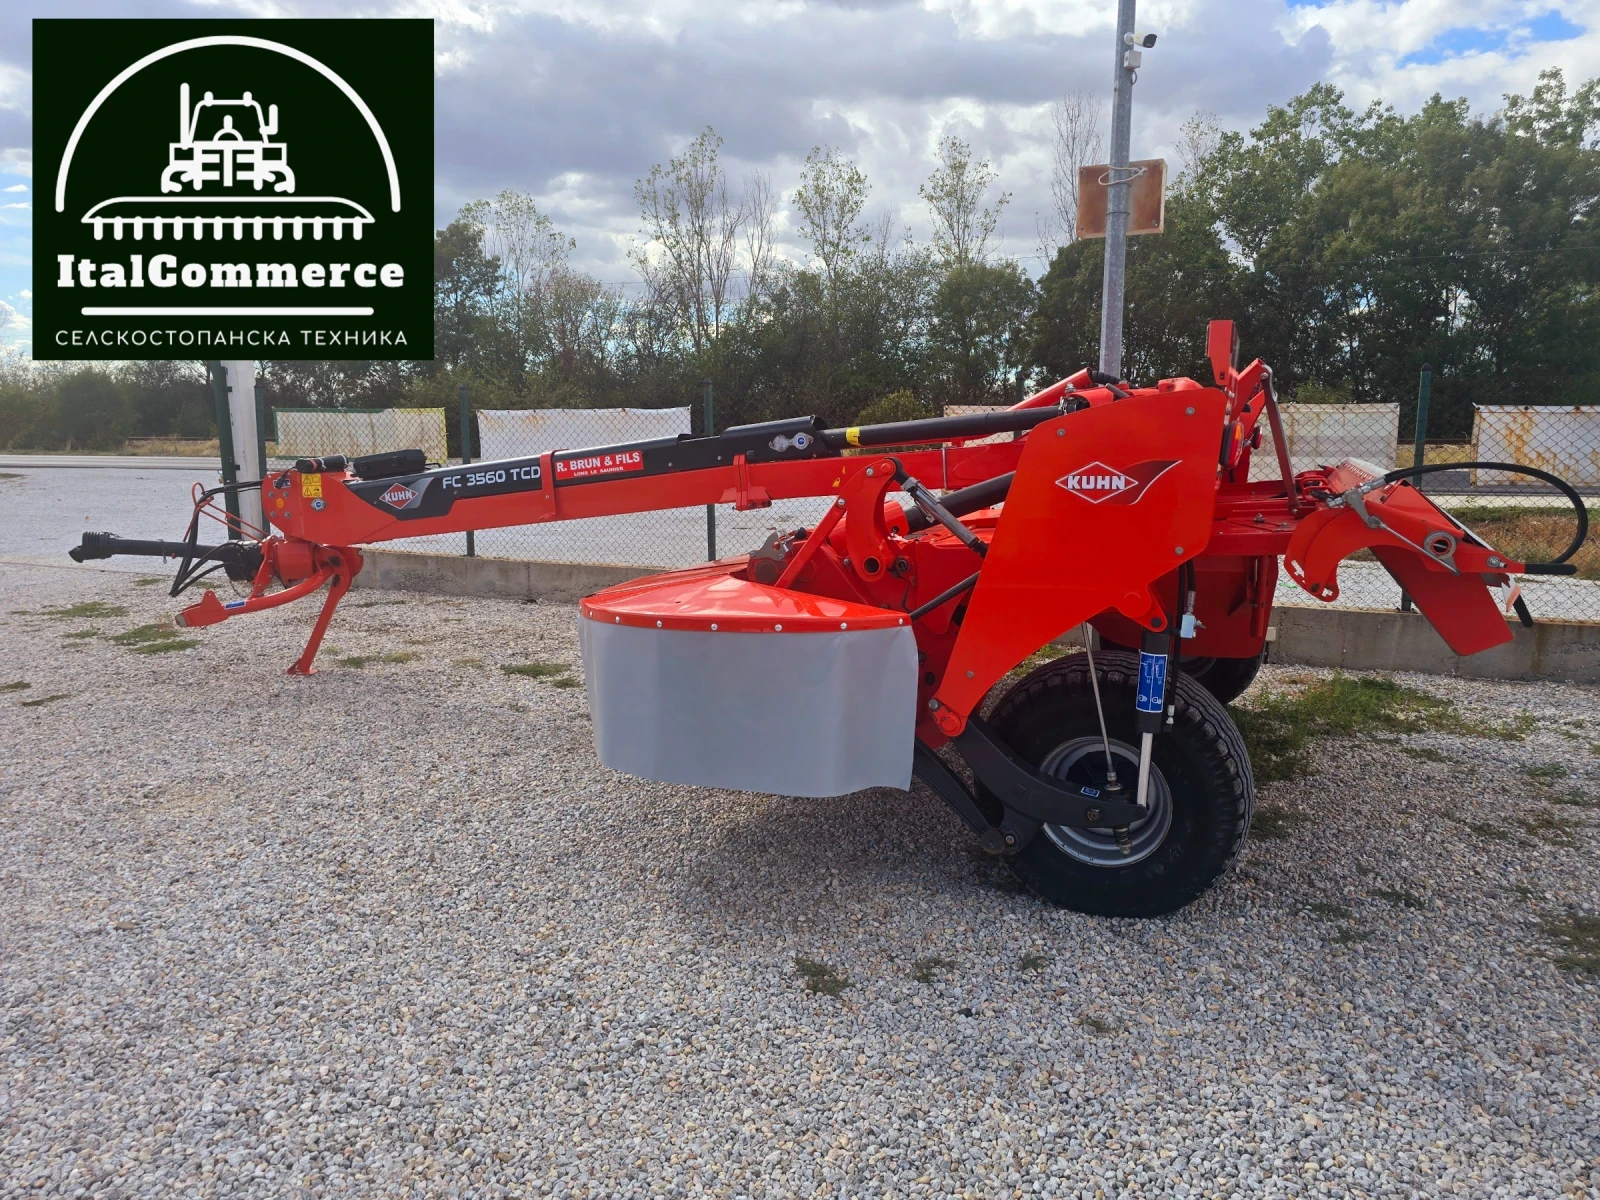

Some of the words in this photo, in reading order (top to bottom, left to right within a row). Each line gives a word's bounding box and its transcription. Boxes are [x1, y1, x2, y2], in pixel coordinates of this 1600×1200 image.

[556, 462, 567, 472] R.
[570, 458, 601, 470] BRUN
[604, 456, 613, 466] &
[616, 452, 640, 464] FILS
[442, 475, 462, 489] FC
[466, 470, 506, 486] 3560
[510, 466, 541, 481] TCD
[1067, 475, 1126, 490] KUHN
[384, 491, 413, 503] KUHN
